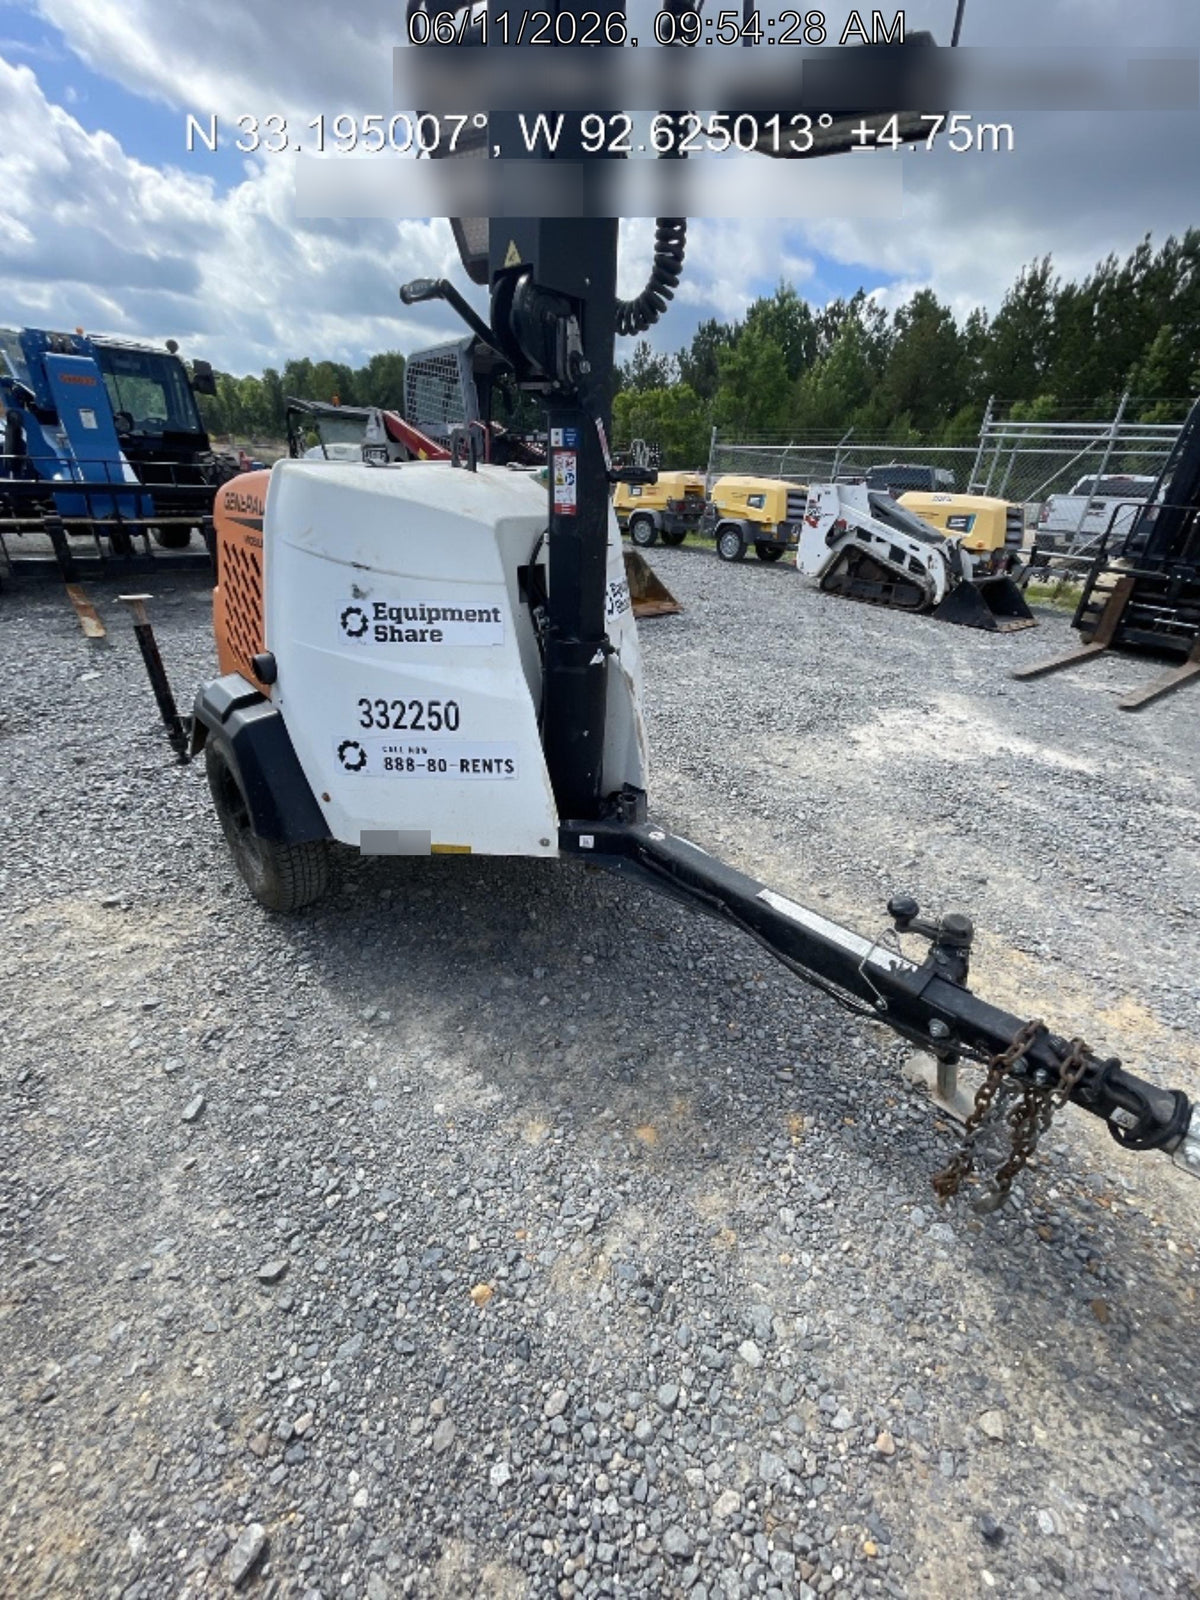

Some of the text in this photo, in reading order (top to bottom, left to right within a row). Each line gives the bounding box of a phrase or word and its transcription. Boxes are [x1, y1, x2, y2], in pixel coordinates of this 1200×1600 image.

[372, 602, 502, 625] Equipment
[374, 625, 443, 643] Share
[358, 698, 460, 731] 332250
[382, 746, 428, 755] CALL NOW
[384, 757, 515, 774] 888-80-RENTS
